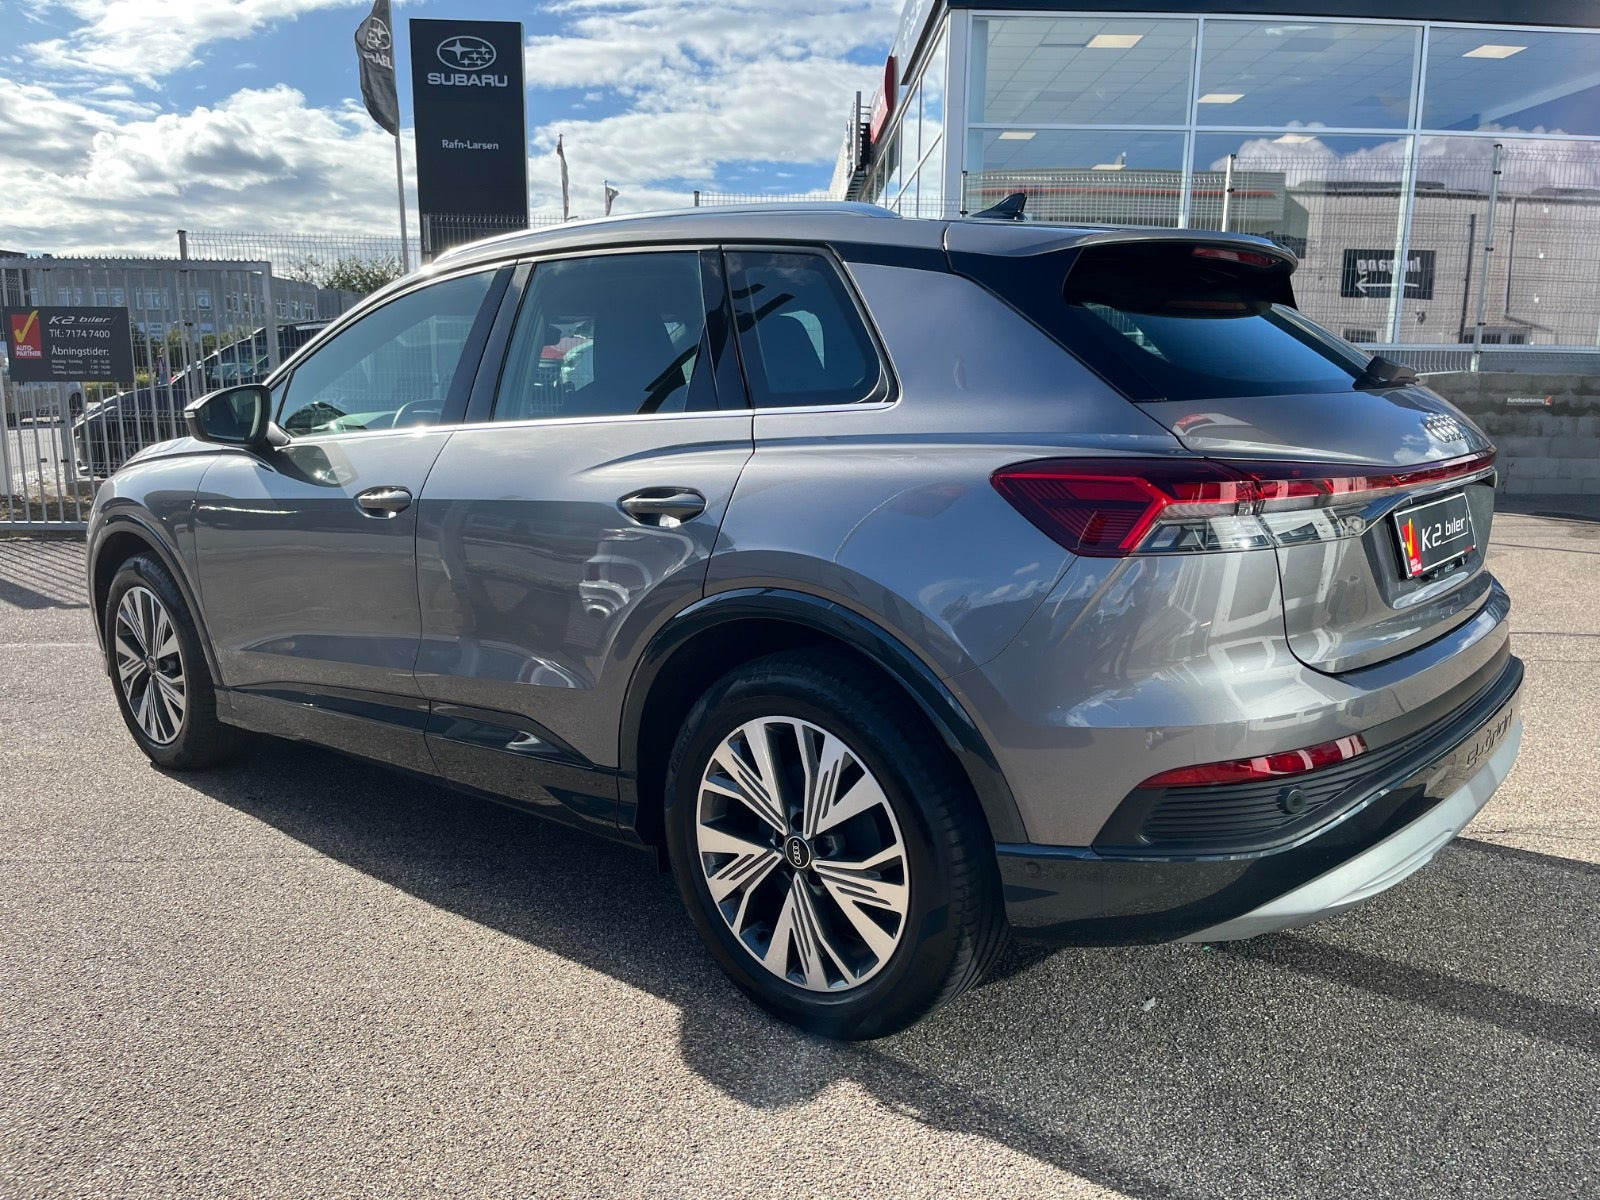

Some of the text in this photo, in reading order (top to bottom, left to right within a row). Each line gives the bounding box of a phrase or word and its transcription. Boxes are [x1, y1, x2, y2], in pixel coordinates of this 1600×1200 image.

[427, 72, 508, 87] SUBARU
[441, 139, 499, 150] Rafn-Larsen
[48, 315, 75, 325] K2
[48, 329, 111, 339] Tlf.: 7174 7400
[51, 345, 110, 358] Åbningstider:
[1421, 517, 1465, 552] K2 biler
